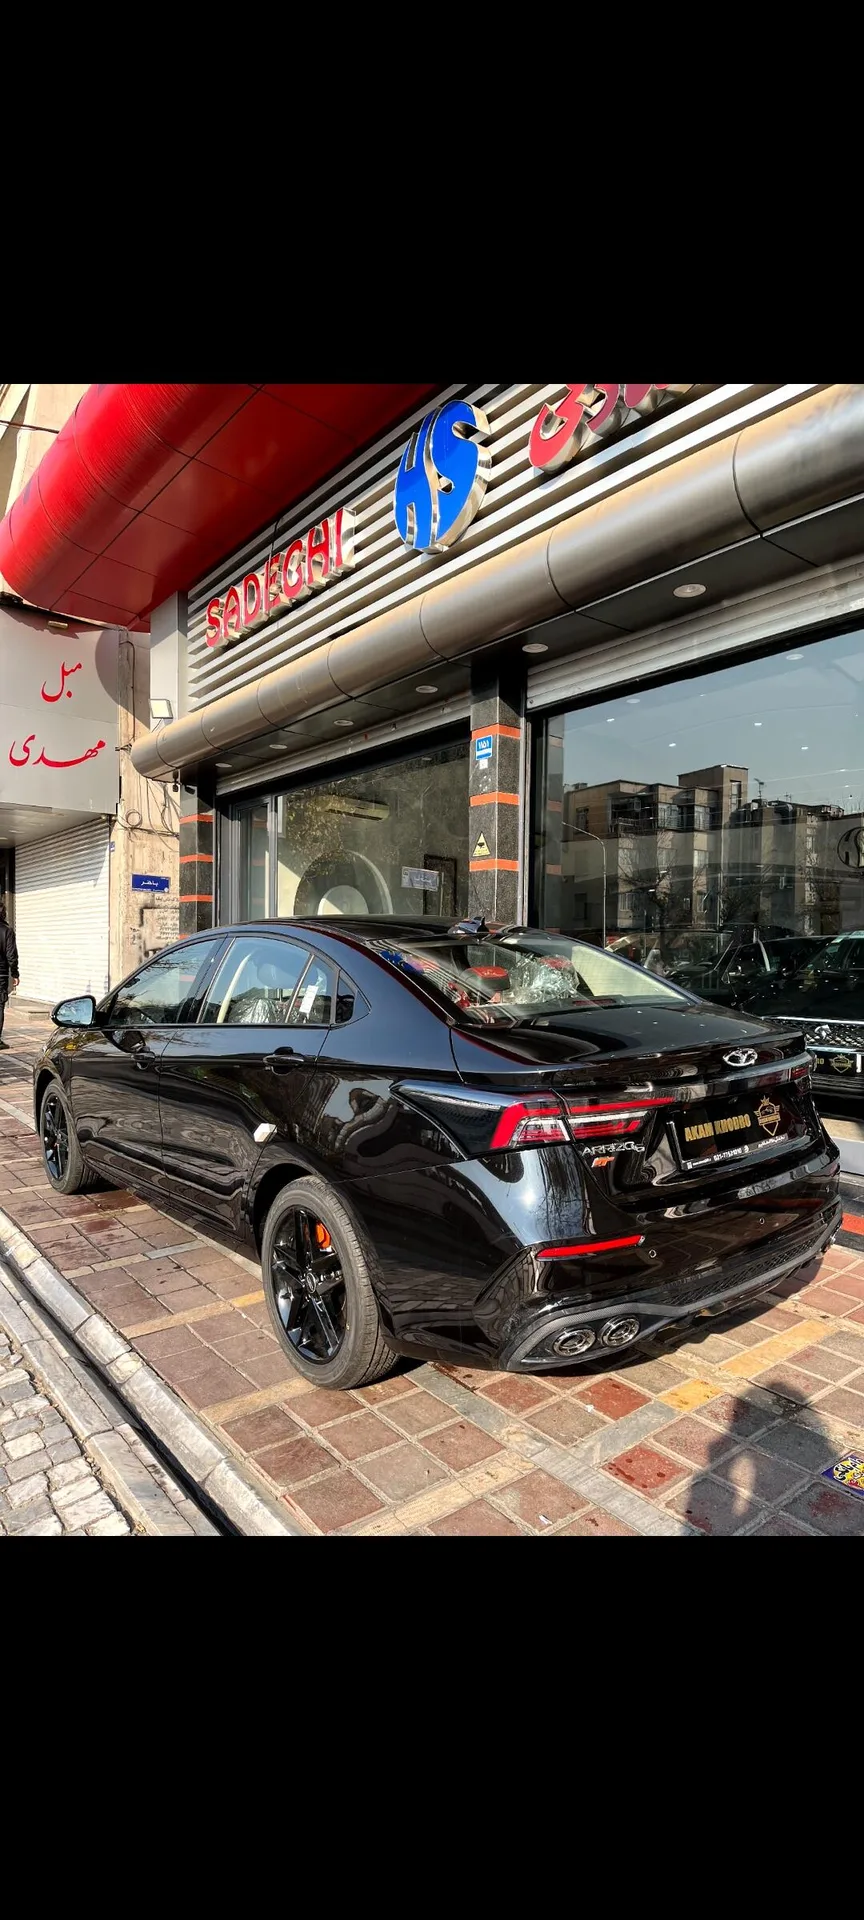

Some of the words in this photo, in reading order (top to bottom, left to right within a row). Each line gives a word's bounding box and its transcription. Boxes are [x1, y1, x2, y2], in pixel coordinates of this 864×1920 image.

[393, 400, 482, 551] HS
[205, 507, 350, 648] SADEGHI
[41, 661, 82, 703] مبل
[9, 734, 106, 768] مهدی
[684, 1122, 714, 1142] AKAM
[713, 1113, 752, 1135] KHODRO
